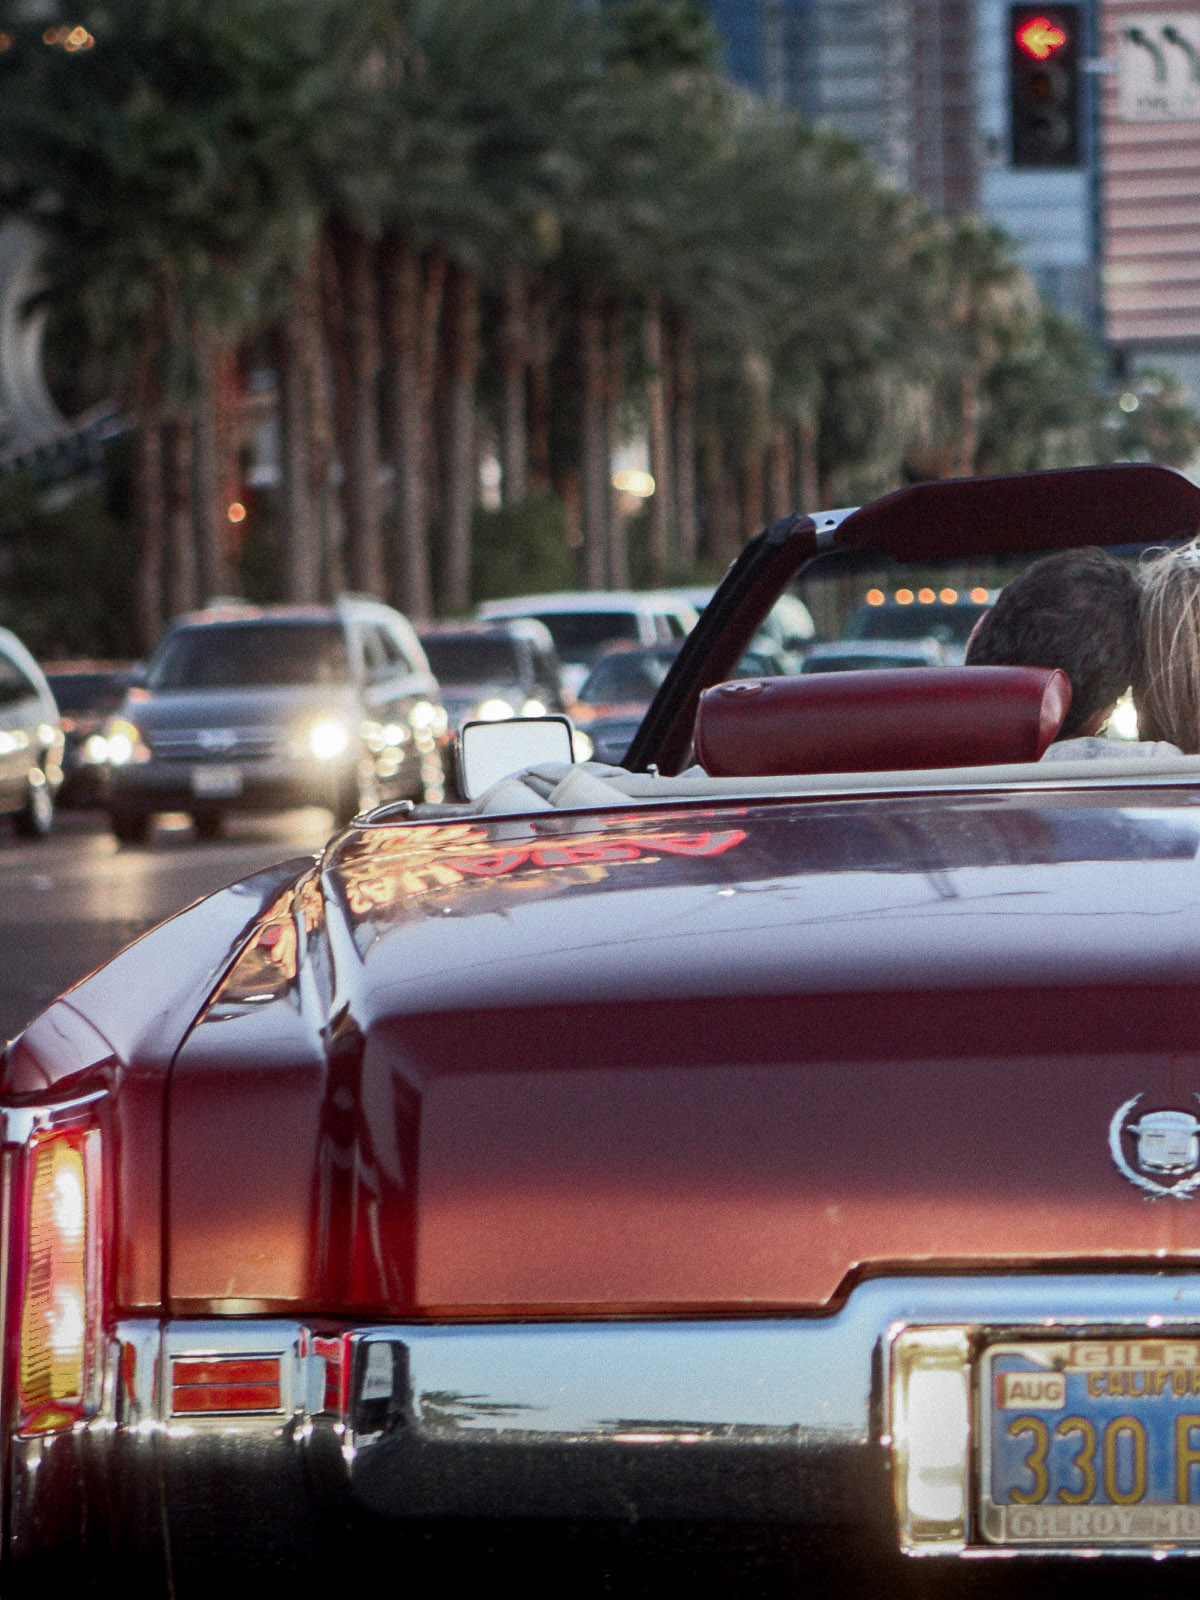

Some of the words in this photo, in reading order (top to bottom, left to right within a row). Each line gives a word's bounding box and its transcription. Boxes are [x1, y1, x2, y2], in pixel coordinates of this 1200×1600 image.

[1010, 1380, 1062, 1401] AUG
[1007, 1414, 1147, 1504] 330
[1010, 1509, 1132, 1537] GILROY
